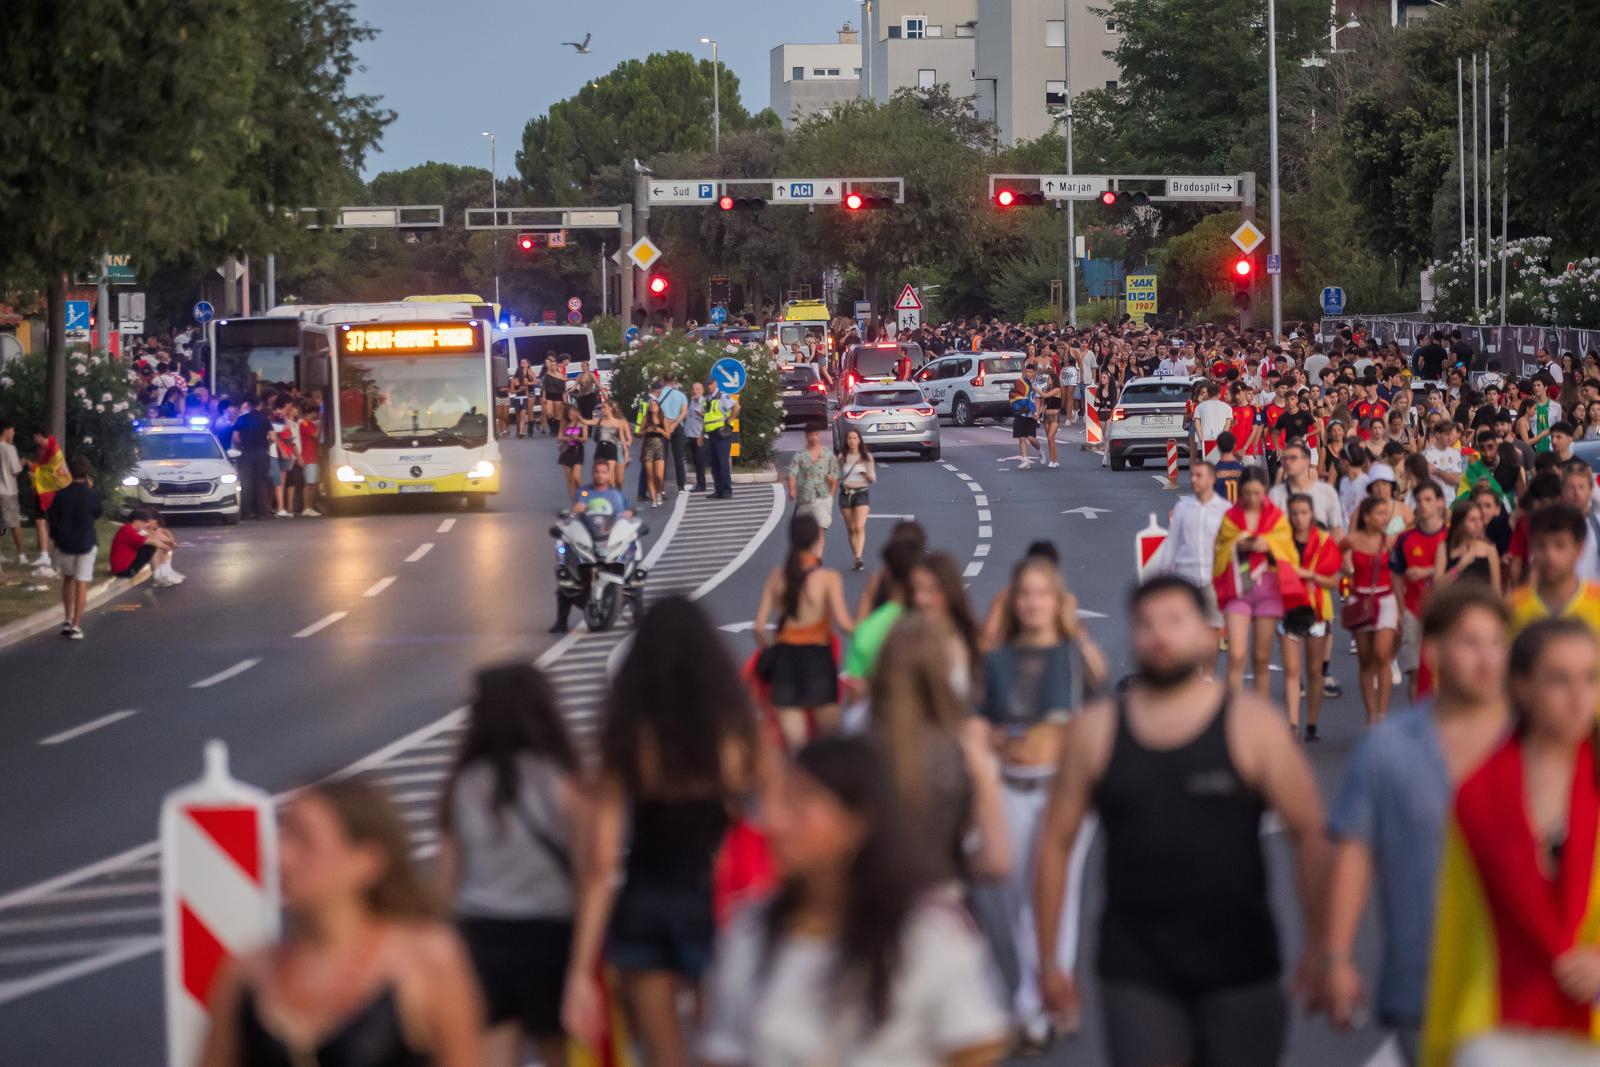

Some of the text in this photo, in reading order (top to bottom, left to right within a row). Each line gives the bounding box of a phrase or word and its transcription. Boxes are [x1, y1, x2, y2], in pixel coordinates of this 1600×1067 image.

[673, 186, 689, 196] Sud
[701, 185, 710, 197] P
[793, 185, 811, 196] ACI
[1060, 182, 1092, 194] Marjan
[1173, 182, 1220, 194] Brodosplit
[1135, 302, 1154, 310] 1987
[346, 331, 365, 351] 37
